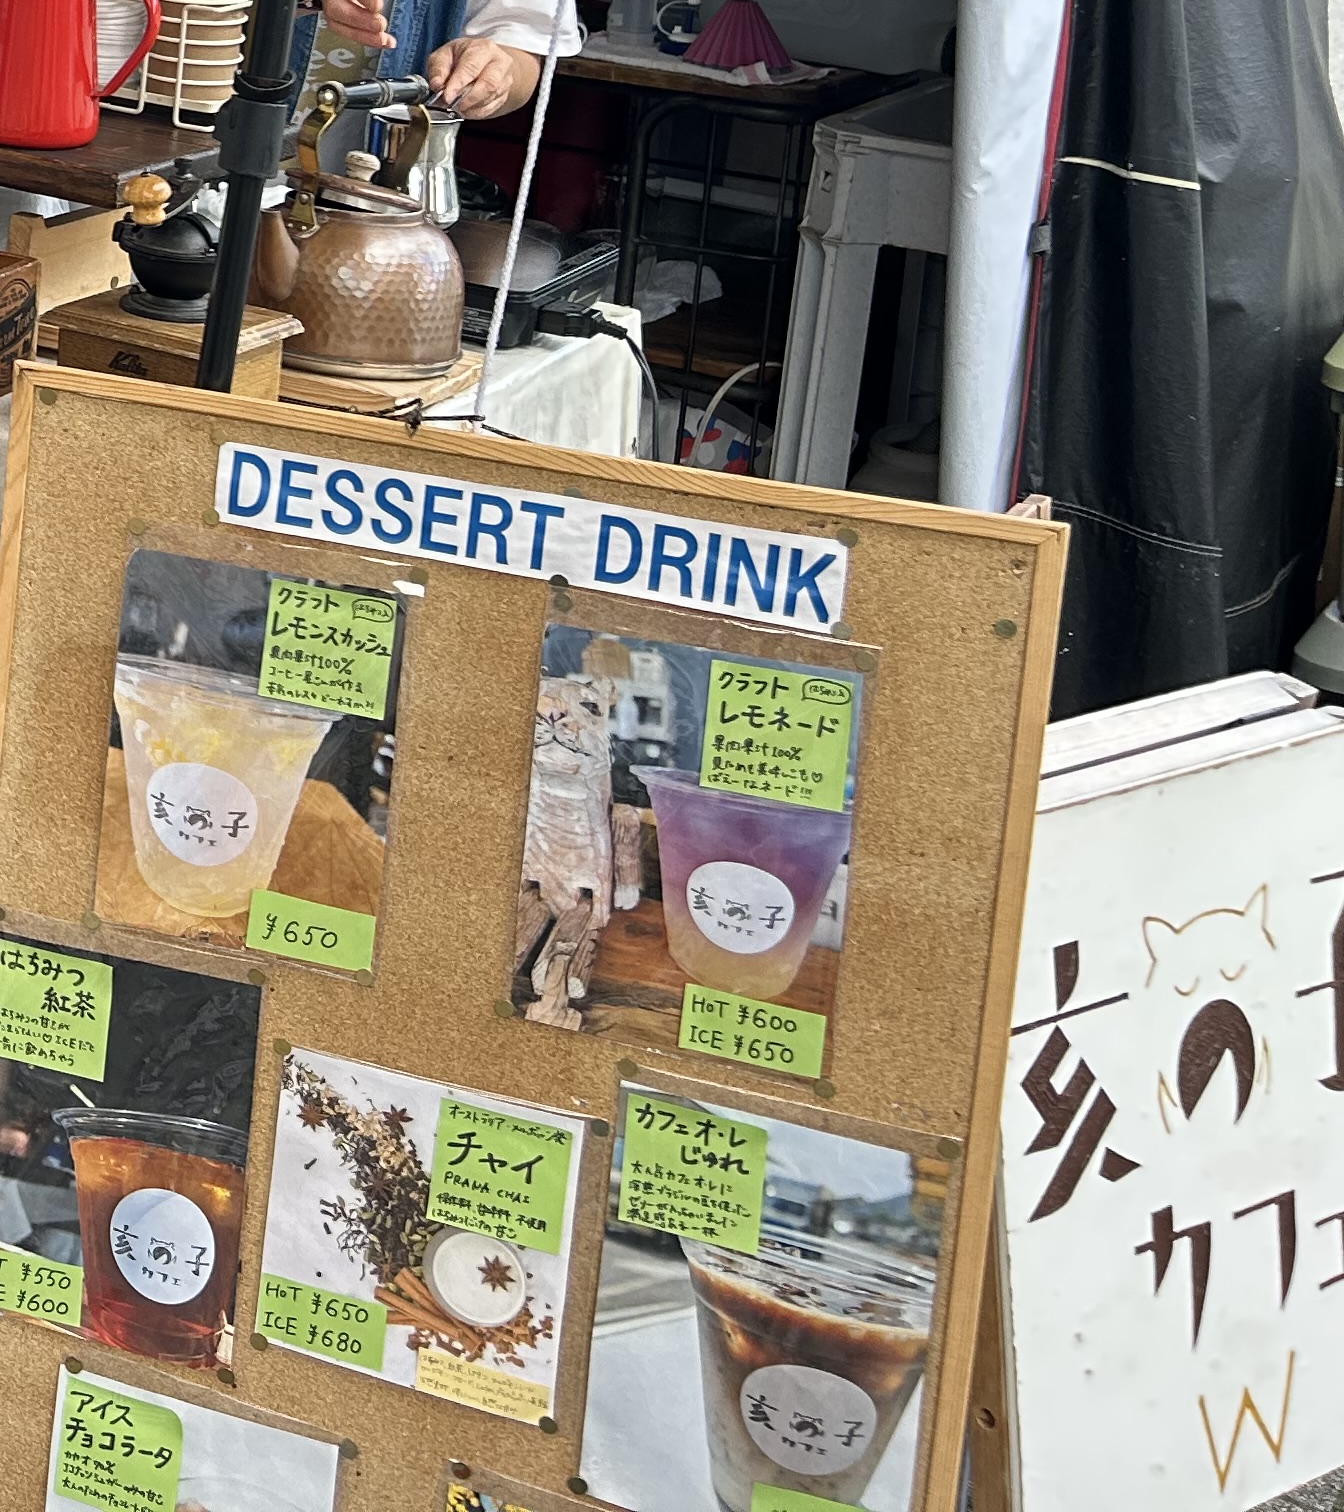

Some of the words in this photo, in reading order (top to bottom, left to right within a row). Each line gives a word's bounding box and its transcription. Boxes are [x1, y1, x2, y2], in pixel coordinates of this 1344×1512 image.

[226, 450, 566, 571] DESSERT
[593, 513, 838, 624] DRINK
[277, 586, 341, 613] クラフト
[270, 610, 393, 658] レモンスカッシュ
[717, 670, 791, 700] クラフト
[719, 699, 841, 739] レモネード
[261, 911, 339, 950] ¥650
[0, 949, 86, 986] はちみつ
[40, 986, 96, 1021] 紅茶
[736, 1004, 798, 1034] ¥600
[733, 1033, 795, 1065] ¥650
[446, 1131, 545, 1185] チャイ
[680, 1144, 751, 1176] じゅれ
[20, 1262, 72, 1291] ¥550
[15, 1288, 70, 1316] ¥600
[311, 1292, 369, 1324] ¥650
[306, 1322, 363, 1356] ¥680
[69, 1389, 135, 1428] アイス
[64, 1416, 174, 1470] チョコラータ
